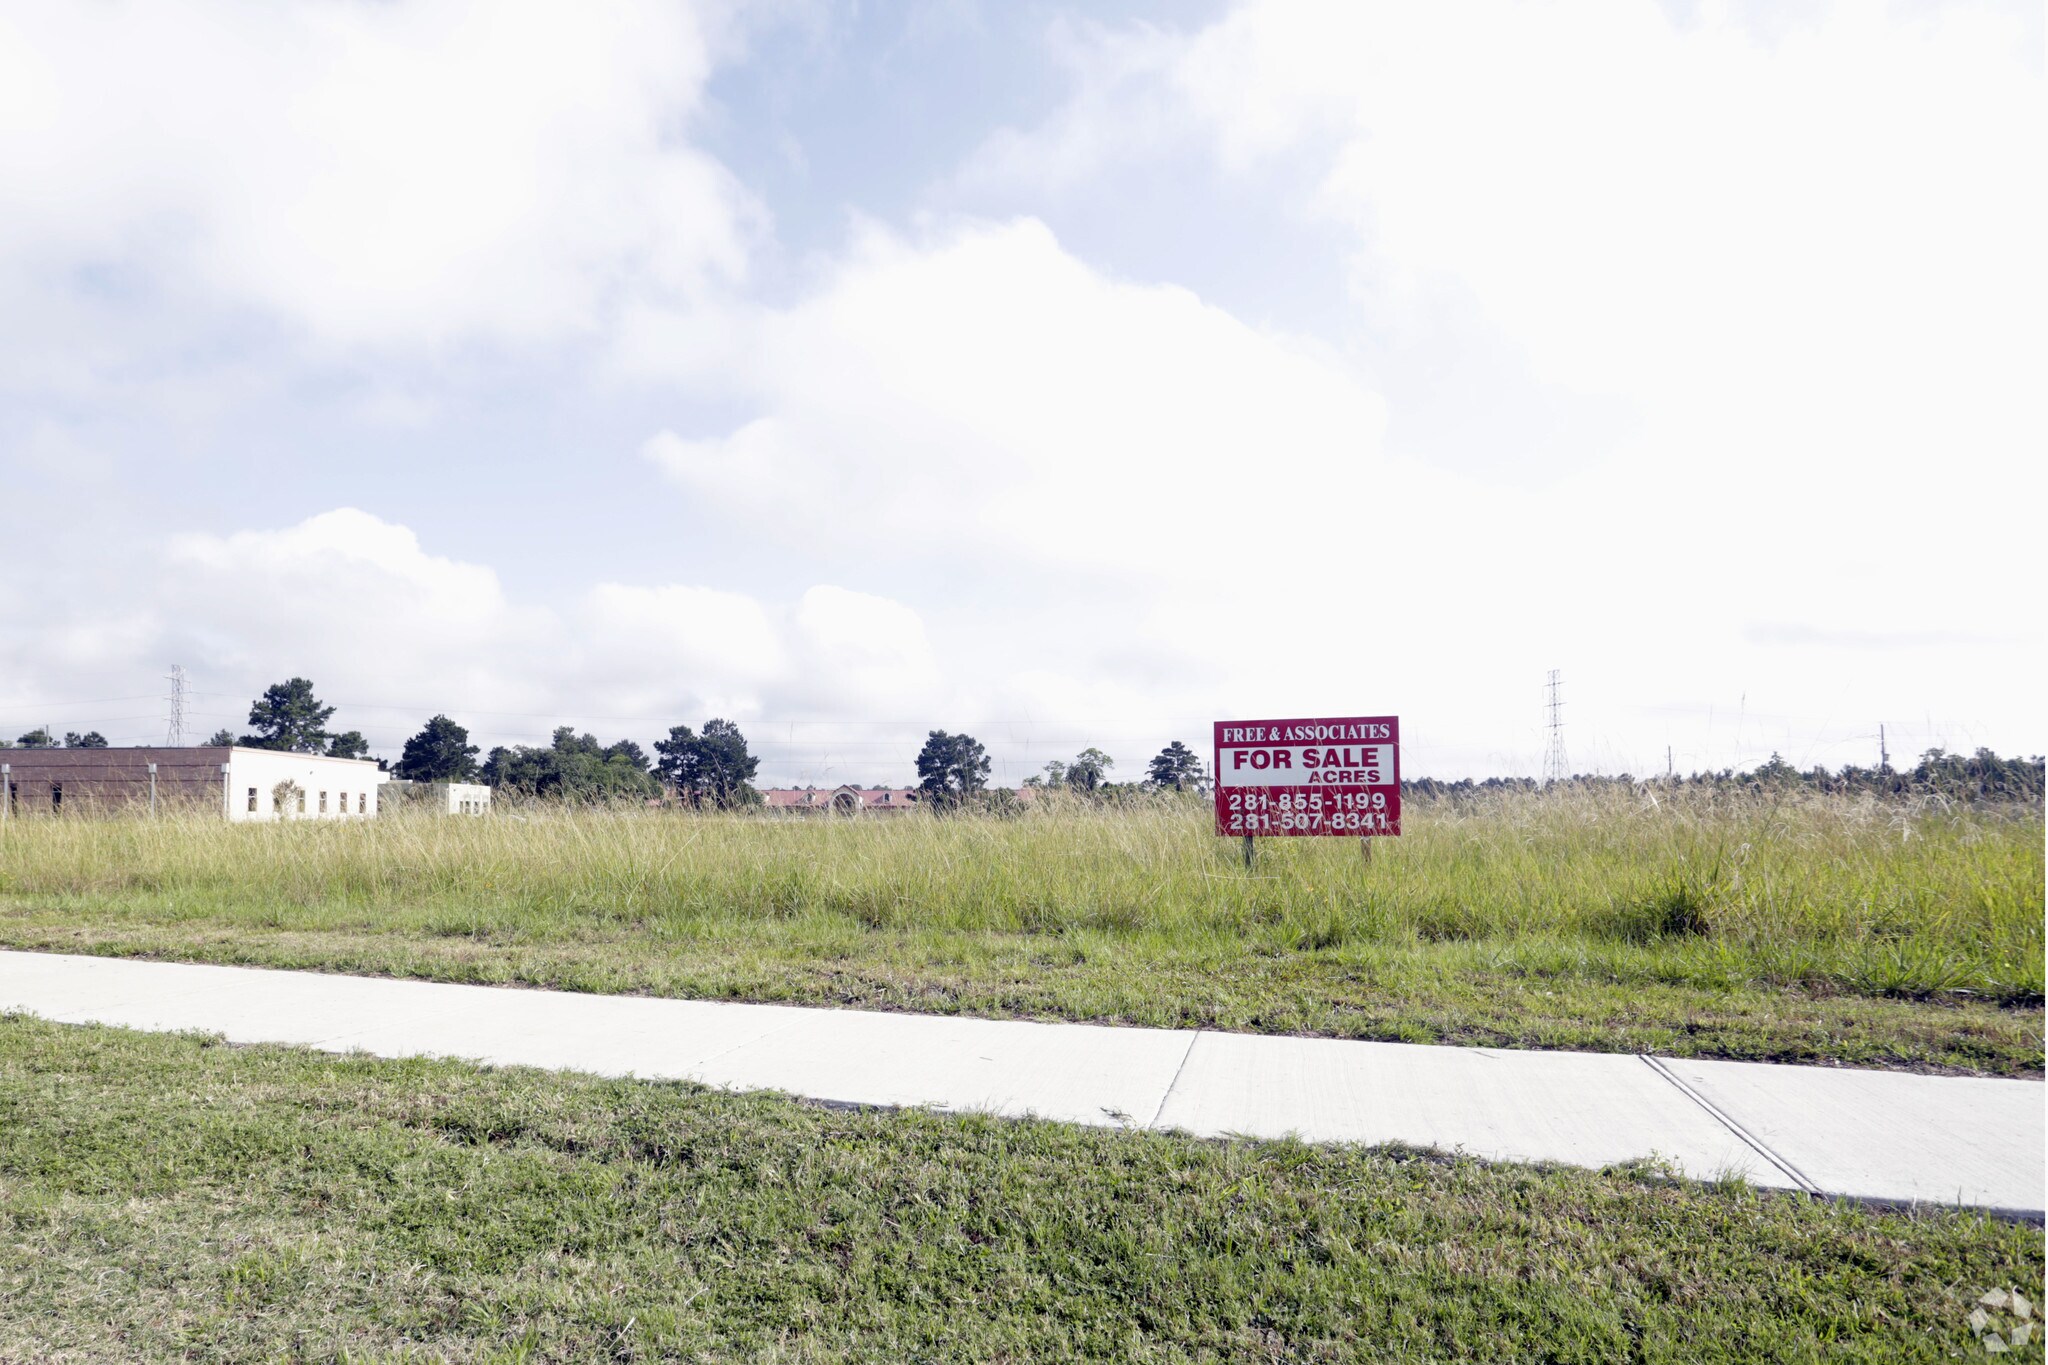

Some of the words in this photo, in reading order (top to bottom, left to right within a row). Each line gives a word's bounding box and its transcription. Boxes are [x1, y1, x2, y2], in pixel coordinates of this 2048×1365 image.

[1223, 726, 1266, 743] FREE
[1269, 726, 1281, 741] &
[1284, 723, 1390, 741] ASSOCIATES
[1233, 749, 1292, 770] FOR
[1302, 748, 1379, 768] SALE
[1308, 770, 1380, 784] ACRES
[1229, 792, 1386, 811] 281-855-1199
